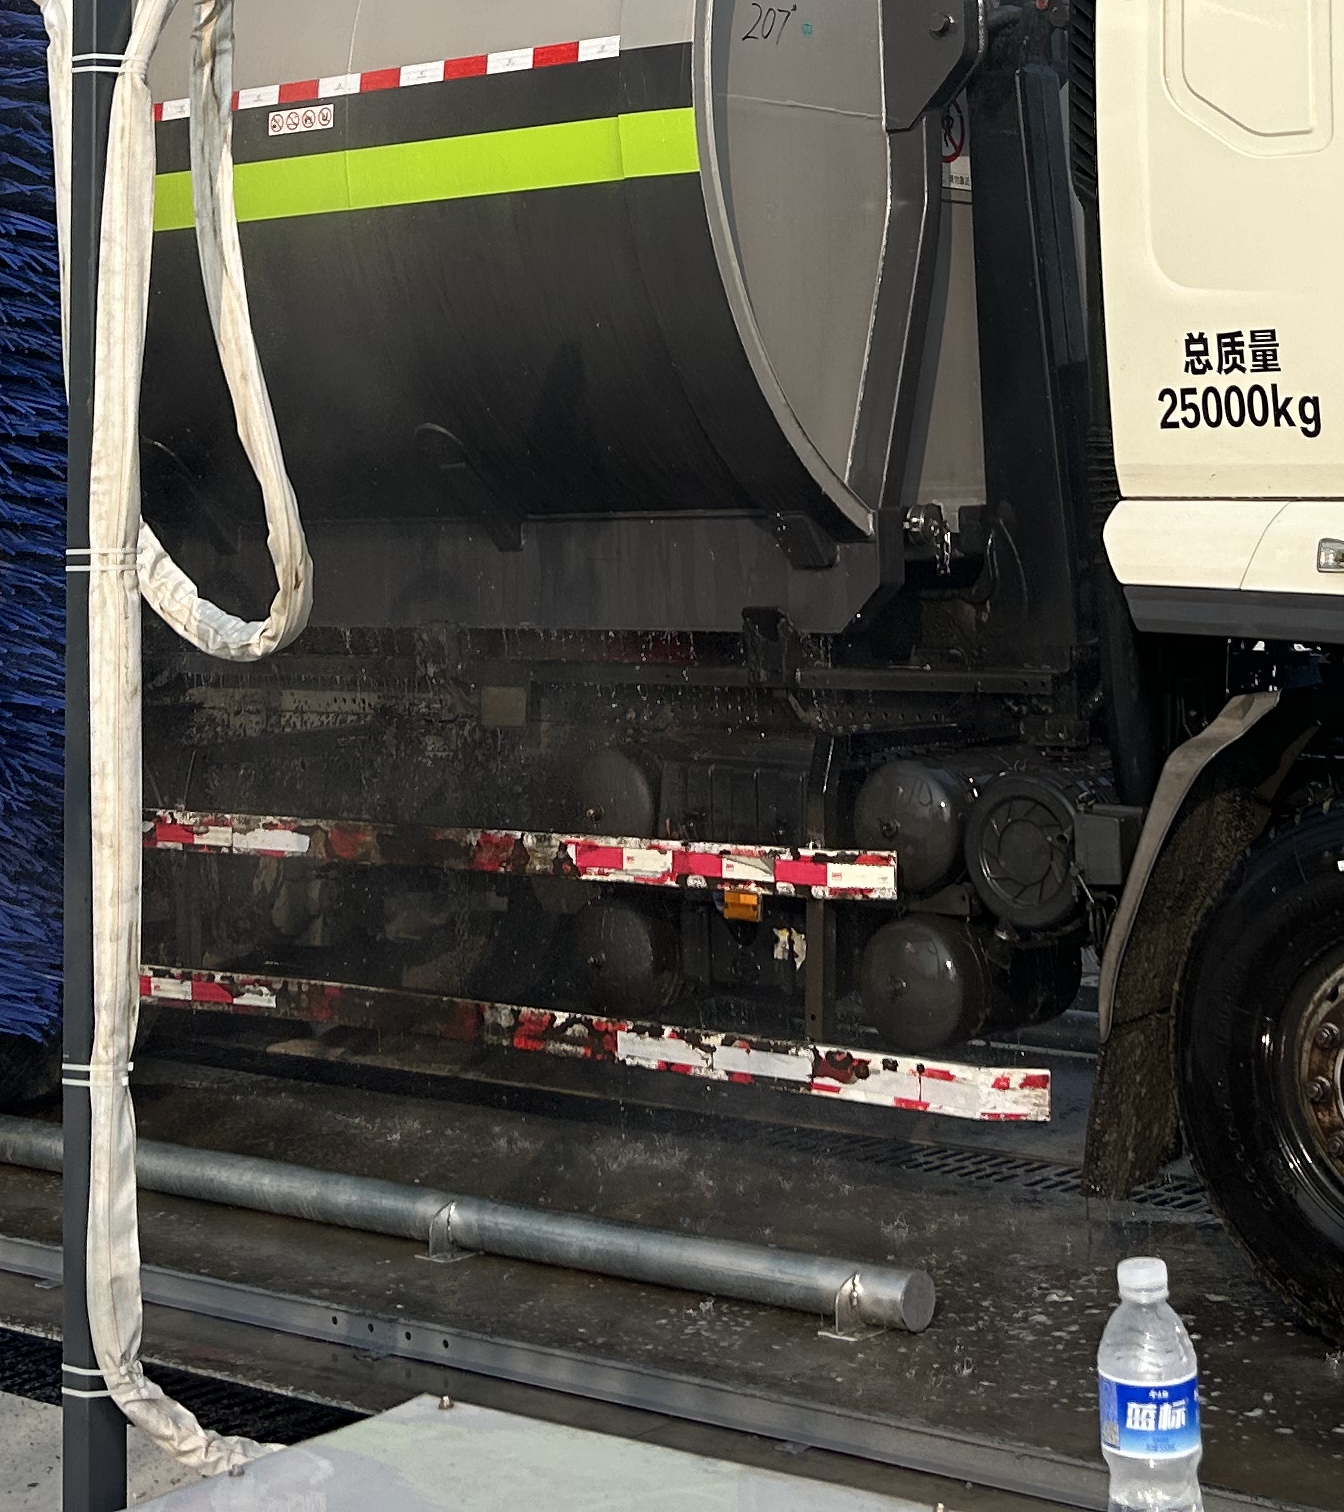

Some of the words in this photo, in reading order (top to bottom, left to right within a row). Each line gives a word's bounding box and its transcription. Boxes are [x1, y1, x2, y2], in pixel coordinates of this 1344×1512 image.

[1183, 328, 1282, 376] 总质量
[1157, 383, 1322, 438] 25000kg
